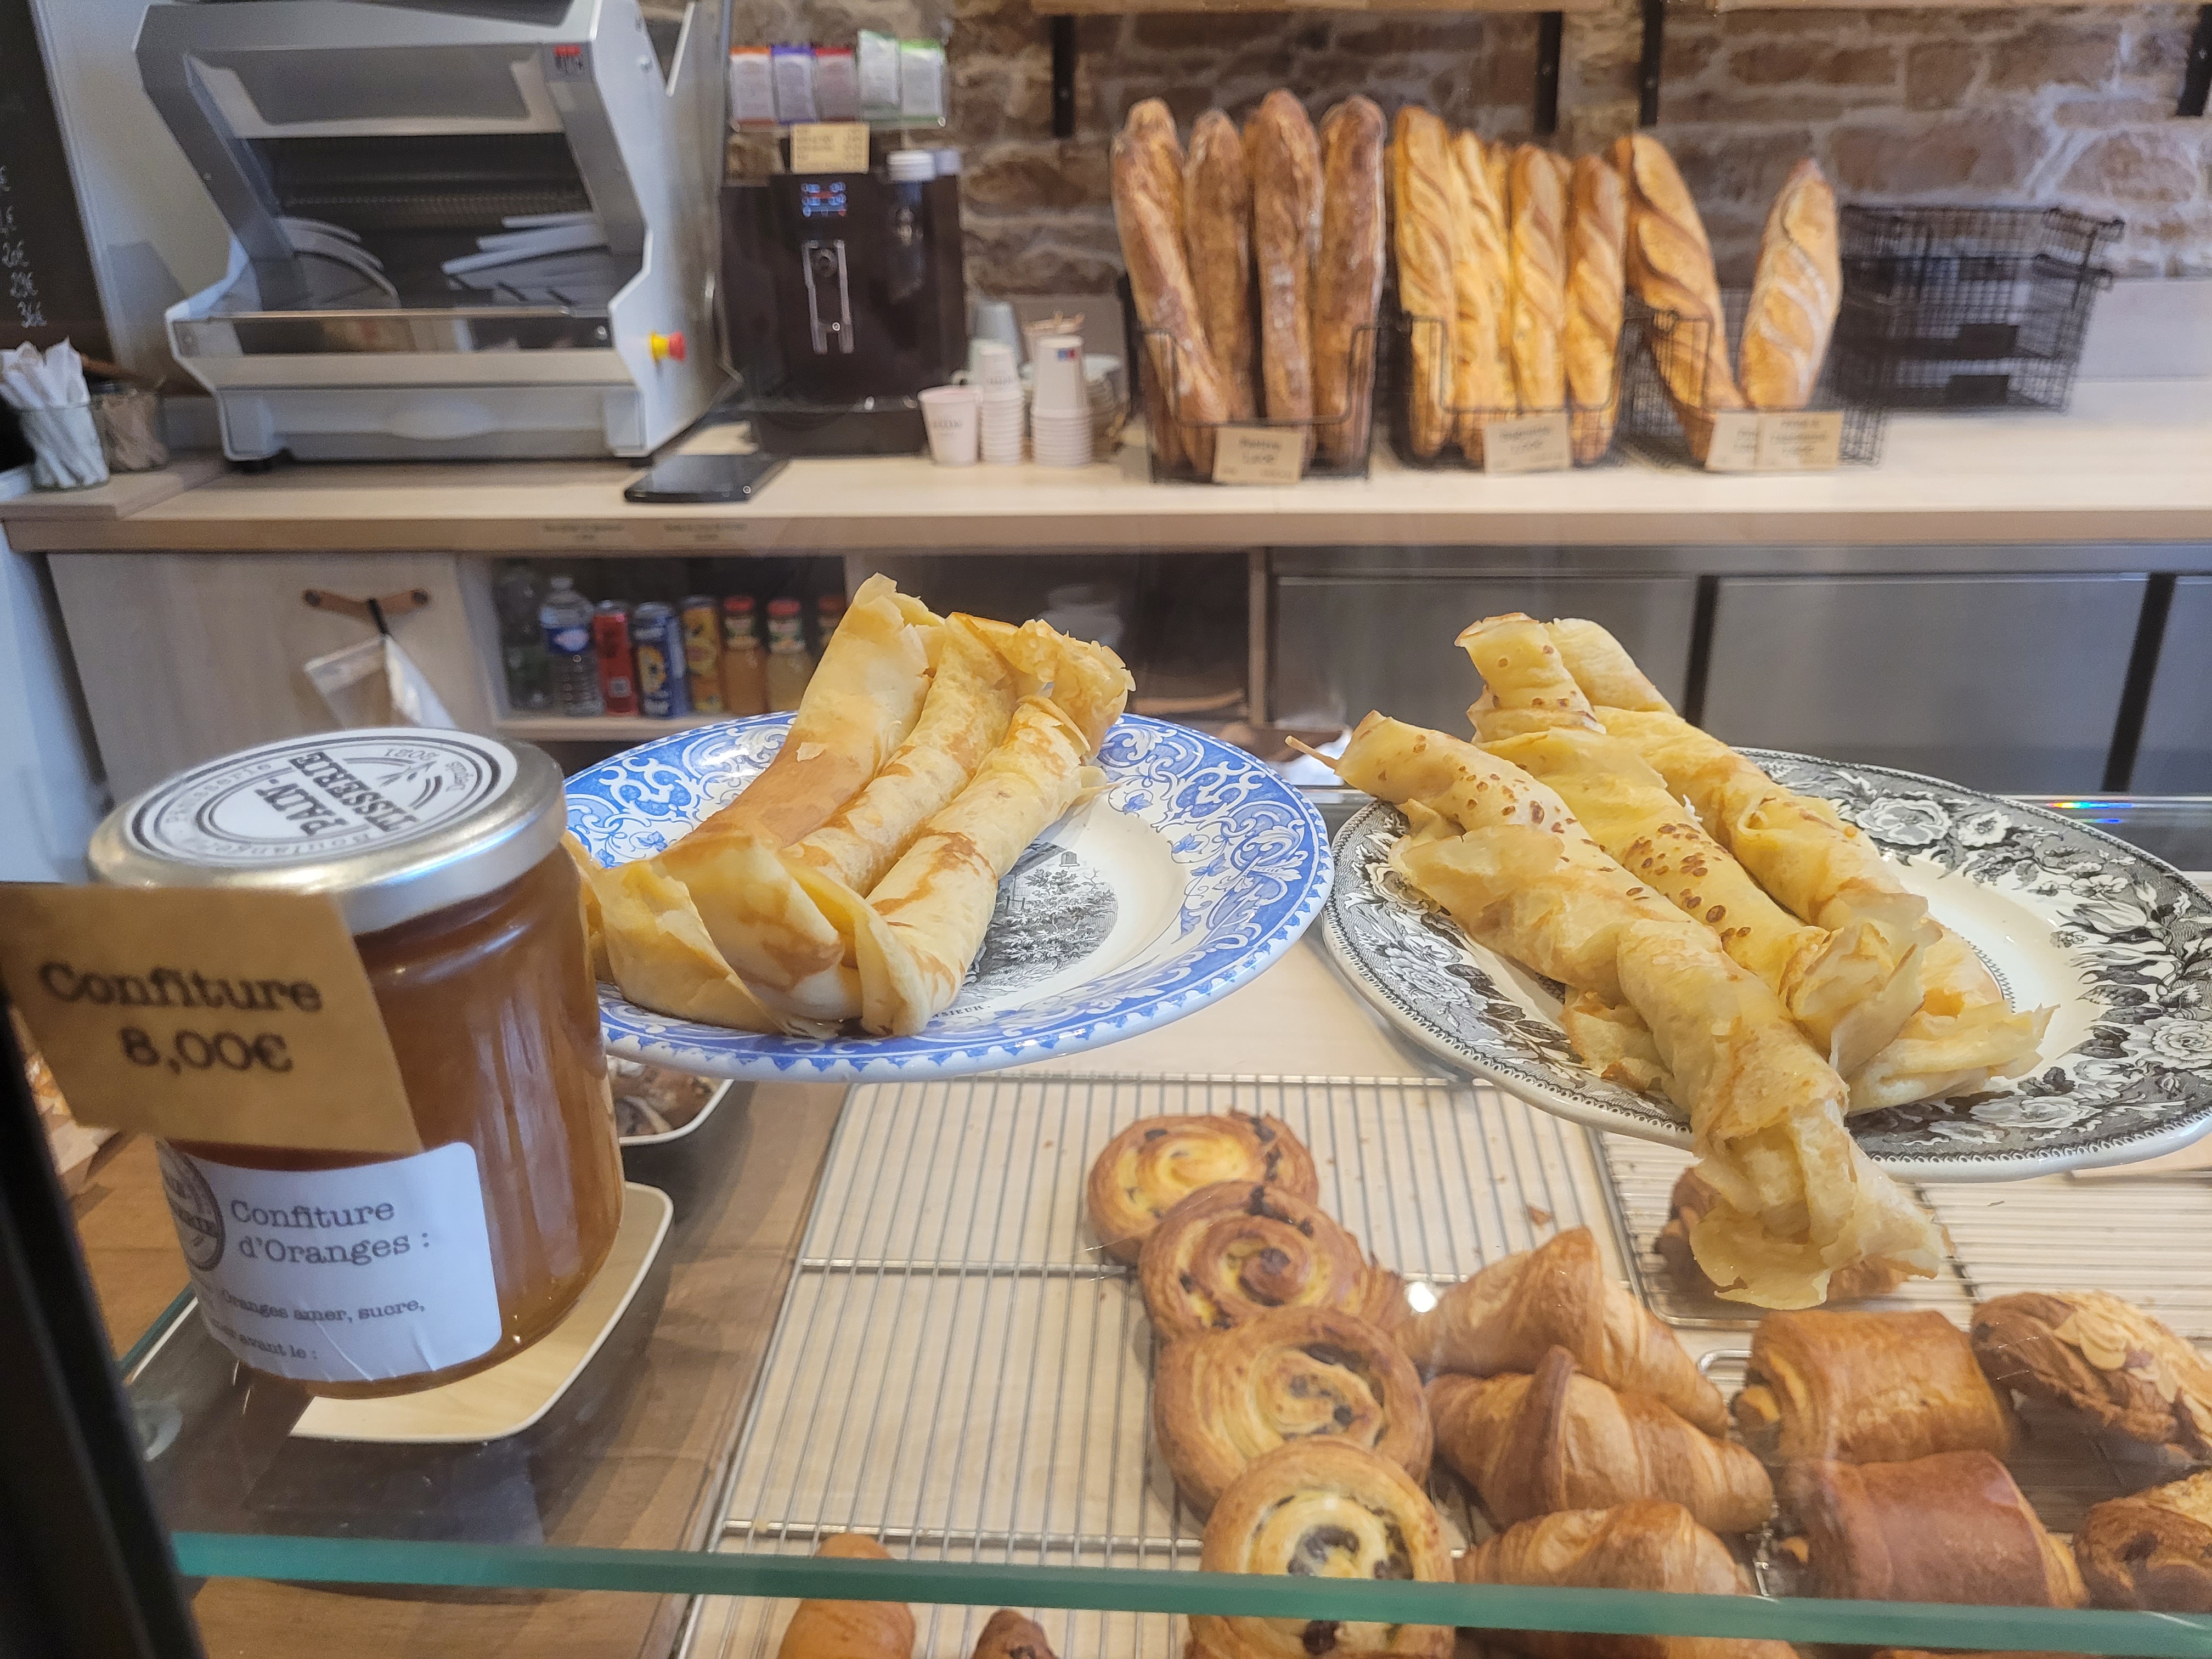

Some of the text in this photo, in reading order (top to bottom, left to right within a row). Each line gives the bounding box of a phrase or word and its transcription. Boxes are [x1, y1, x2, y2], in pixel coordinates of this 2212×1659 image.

[288, 751, 421, 833] TISSERIE
[384, 748, 474, 793] Depuis 2021
[254, 777, 351, 836] PAIN-
[38, 960, 323, 1013] Confiture
[120, 1025, 294, 1075] 8,00€
[231, 1199, 396, 1229] Confiture
[239, 1234, 411, 1266] d'Oranges
[293, 1308, 353, 1324] amer,
[358, 1299, 425, 1321] sucre,
[239, 1334, 287, 1357] avant
[289, 1344, 307, 1359] le
